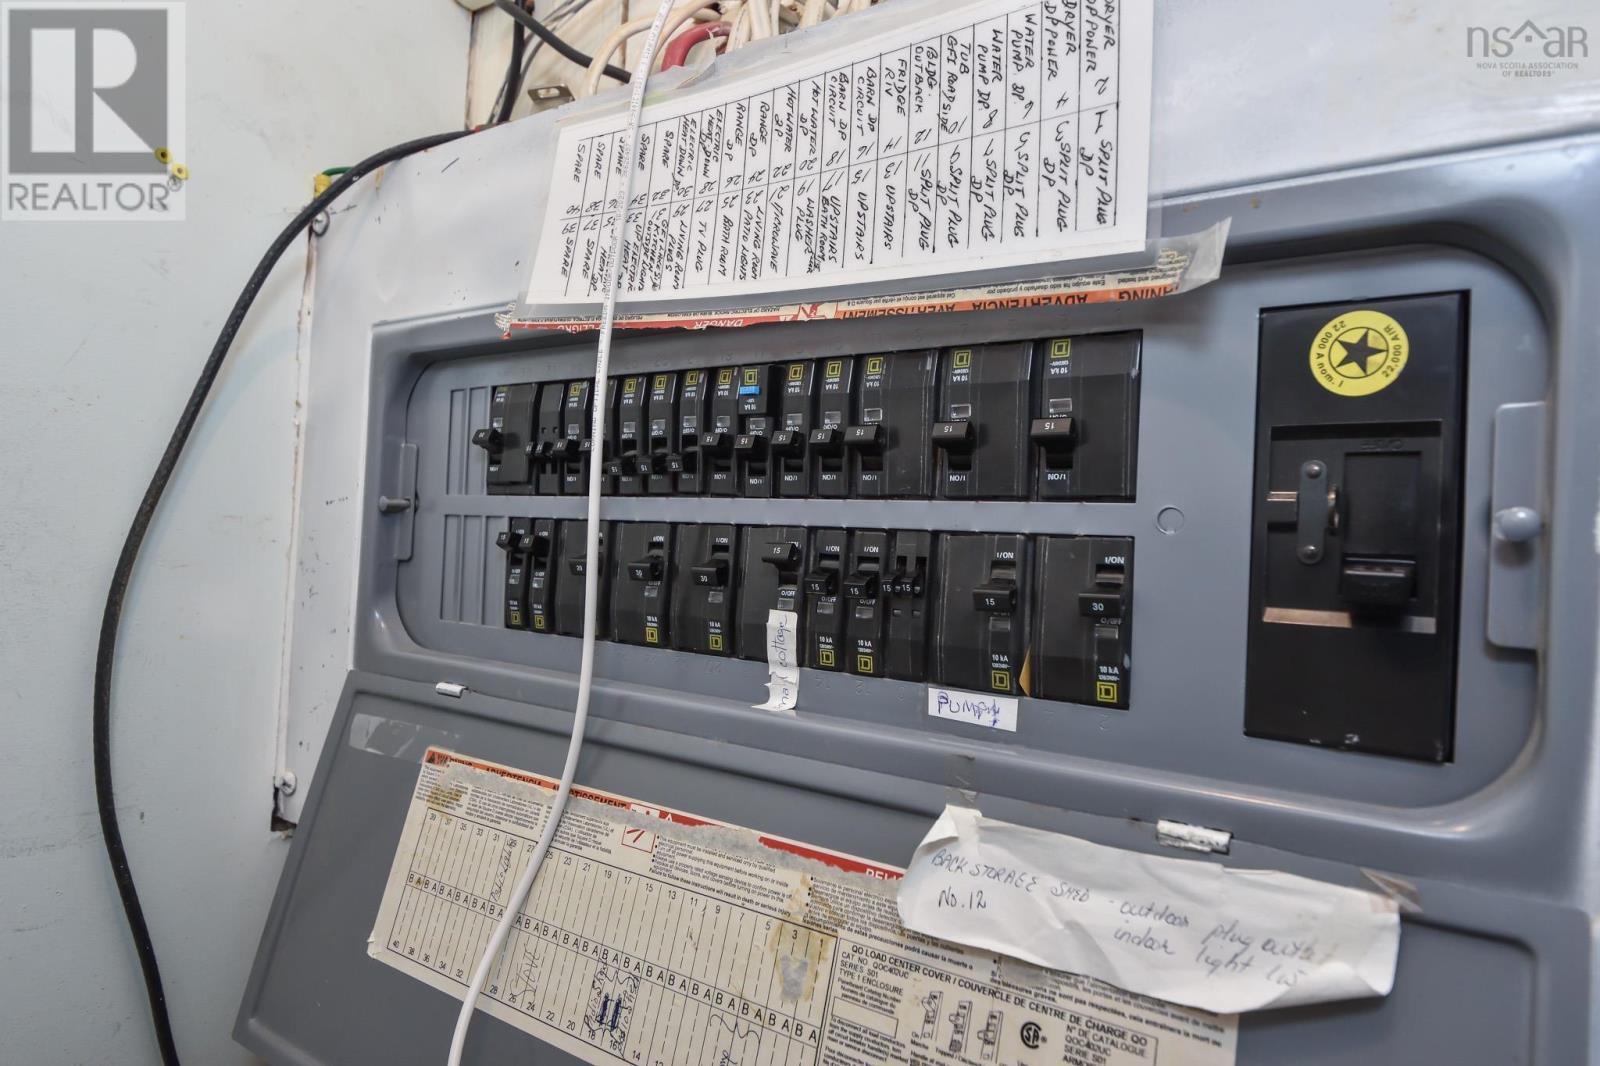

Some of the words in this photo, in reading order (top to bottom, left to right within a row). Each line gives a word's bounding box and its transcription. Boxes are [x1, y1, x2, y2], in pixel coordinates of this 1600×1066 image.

[960, 44, 969, 74] TUB
[991, 29, 1002, 83] WATER
[1025, 14, 1036, 68] WATER
[978, 44, 987, 84] PUMP
[828, 76, 836, 127] CIRCUIT
[838, 73, 848, 110] BARN
[867, 67, 876, 106] BARN
[894, 59, 906, 116] FRIDGE
[735, 103, 745, 146] RANGE
[760, 101, 769, 144] RANGE
[574, 144, 585, 182] SPARE
[595, 142, 605, 179] SPARE
[639, 134, 650, 170] SPARE
[662, 131, 673, 167] SPARE
[1059, 143, 1070, 184] SPLIT
[1079, 147, 1093, 176] DP
[1100, 140, 1112, 185] SPLIT
[920, 169, 931, 210] SPLIT
[949, 167, 962, 208] SPLIT
[986, 159, 996, 201] SPLIT
[1015, 152, 1028, 198] SPLIT
[1042, 158, 1055, 186] DP
[883, 185, 895, 249] UPSTAIRS
[982, 204, 996, 241] PLUG
[1014, 204, 1028, 237] PLUG
[1057, 189, 1070, 232] PLUG
[1096, 187, 1112, 224] PLUG
[676, 221, 687, 259] LIVING
[699, 221, 706, 238] TV
[754, 207, 763, 249] LIVING
[828, 196, 840, 263] UPSTAIRS
[855, 192, 867, 260] UPSTAIRS
[919, 213, 931, 250] PLUG
[948, 210, 962, 248] PLUG
[561, 238, 573, 277] SPARE
[582, 240, 594, 279] SPARE
[696, 242, 705, 272] PLUG
[851, 588, 859, 596] 15
[985, 599, 996, 607] 15
[1093, 603, 1105, 612] 30
[605, 871, 612, 879] 19
[625, 877, 632, 886] 17
[646, 884, 654, 893] 15
[669, 891, 677, 900] 13
[716, 905, 721, 914] 9
[766, 921, 771, 931] 5
[792, 930, 798, 940] 3
[840, 969, 856, 979] TYPE
[862, 976, 903, 995] ENCLOSURE
[866, 949, 886, 962] LOAD
[889, 956, 920, 972] CENTER
[922, 968, 951, 983] COVER
[958, 979, 1011, 1003] COUVERCLE
[1014, 996, 1027, 1009] DE
[1029, 1002, 1065, 1020] CENTRE
[1070, 1014, 1083, 1027] DE
[1086, 1020, 1127, 1040] CHARGE
[568, 1021, 576, 1031] 20
